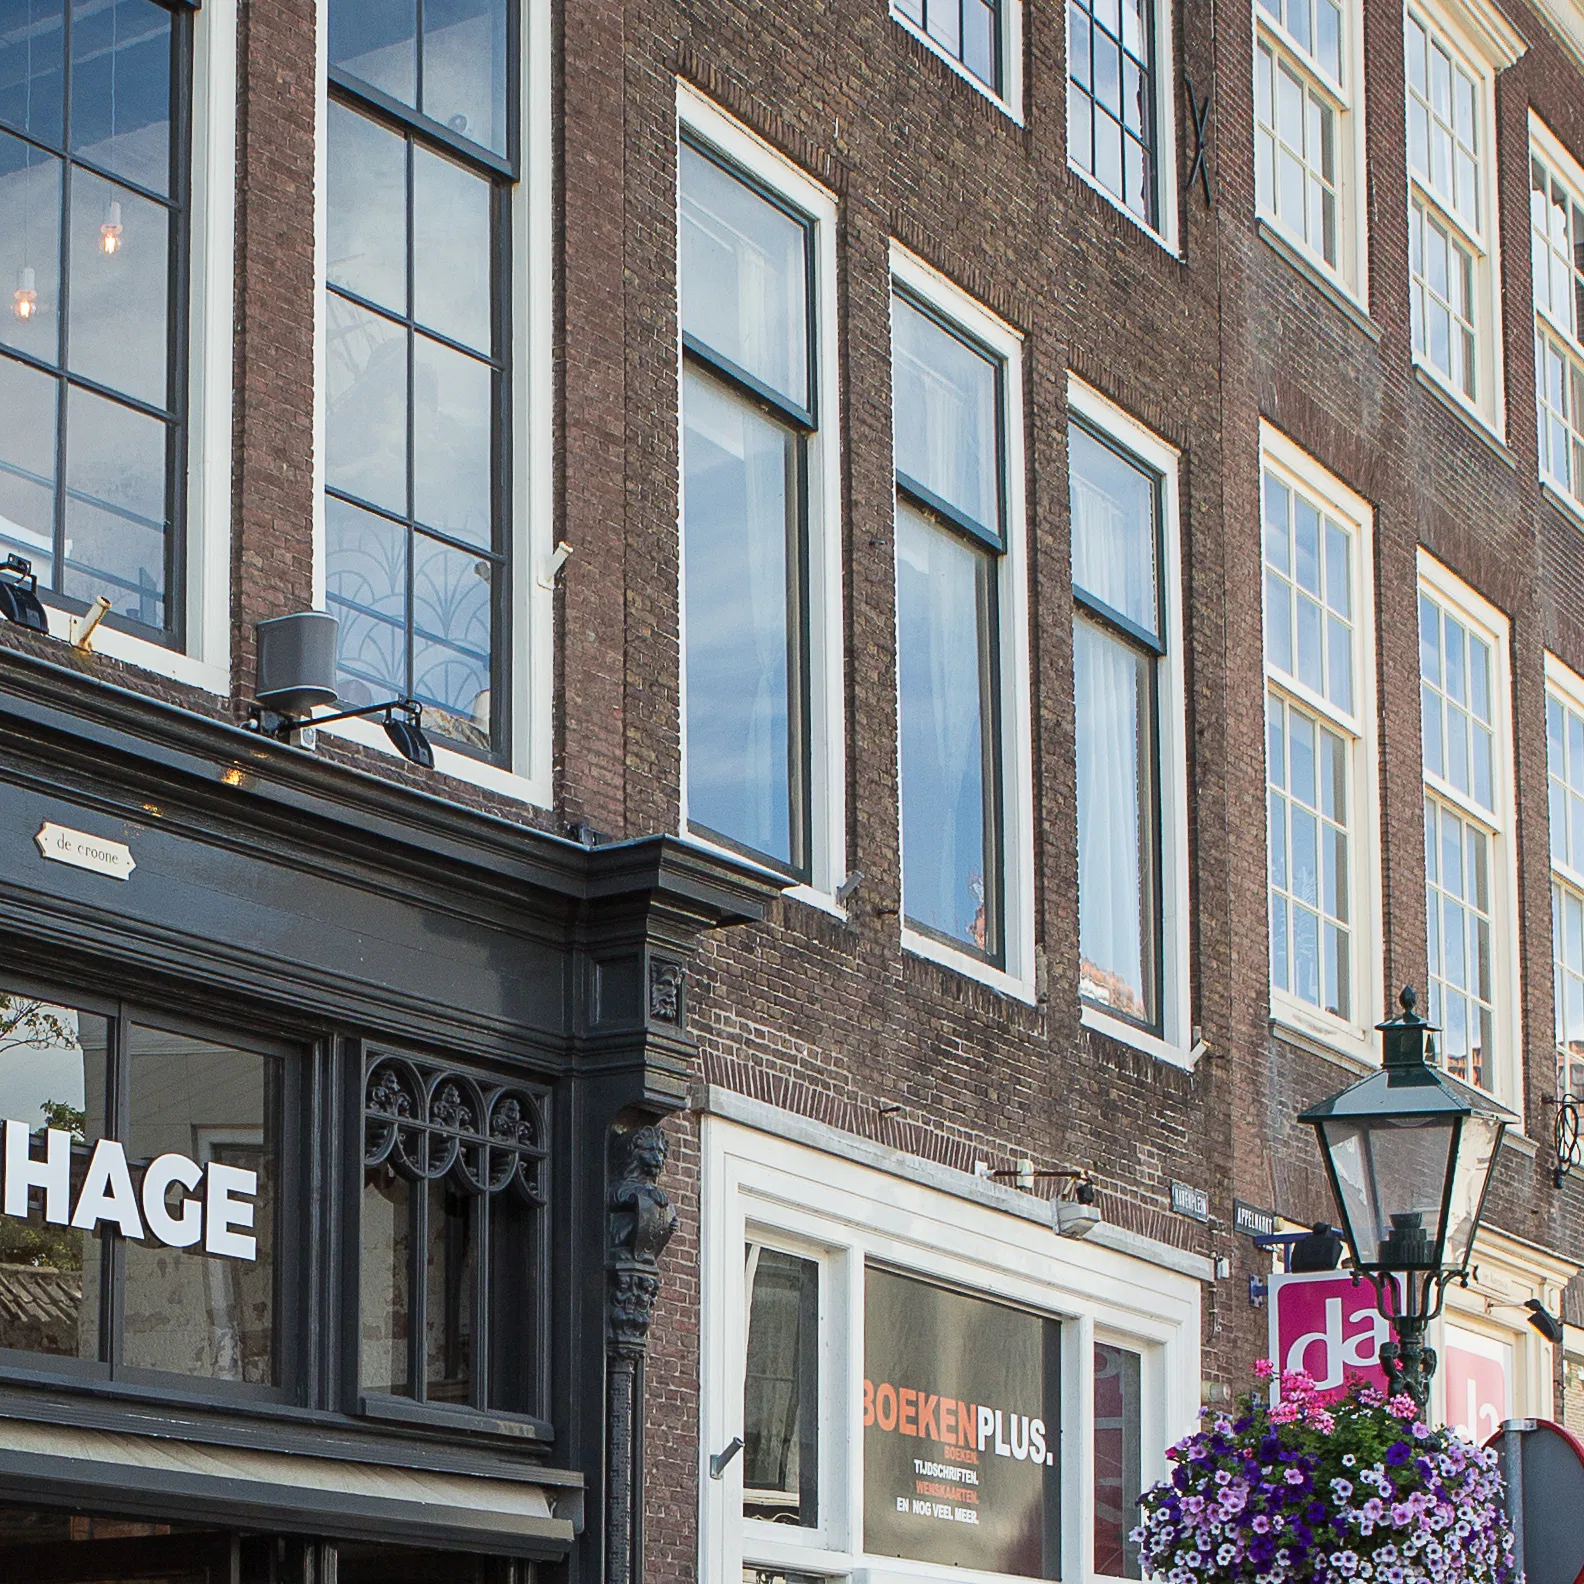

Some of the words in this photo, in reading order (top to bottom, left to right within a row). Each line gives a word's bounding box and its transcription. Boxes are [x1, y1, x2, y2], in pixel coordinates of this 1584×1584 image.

[56, 832, 72, 851] de
[1285, 1297, 1392, 1391] da
[863, 1378, 1054, 1467] BOEKENPLUS.
[943, 1444, 980, 1465] BOEKEN.
[913, 1458, 980, 1486] TIJDSCHRIFTEN.
[915, 1479, 980, 1505] WENSKAARTEN.
[896, 1496, 910, 1513] EN
[912, 1498, 932, 1517] NOG
[932, 1502, 954, 1521] VEEL
[954, 1507, 980, 1526] MEER.
